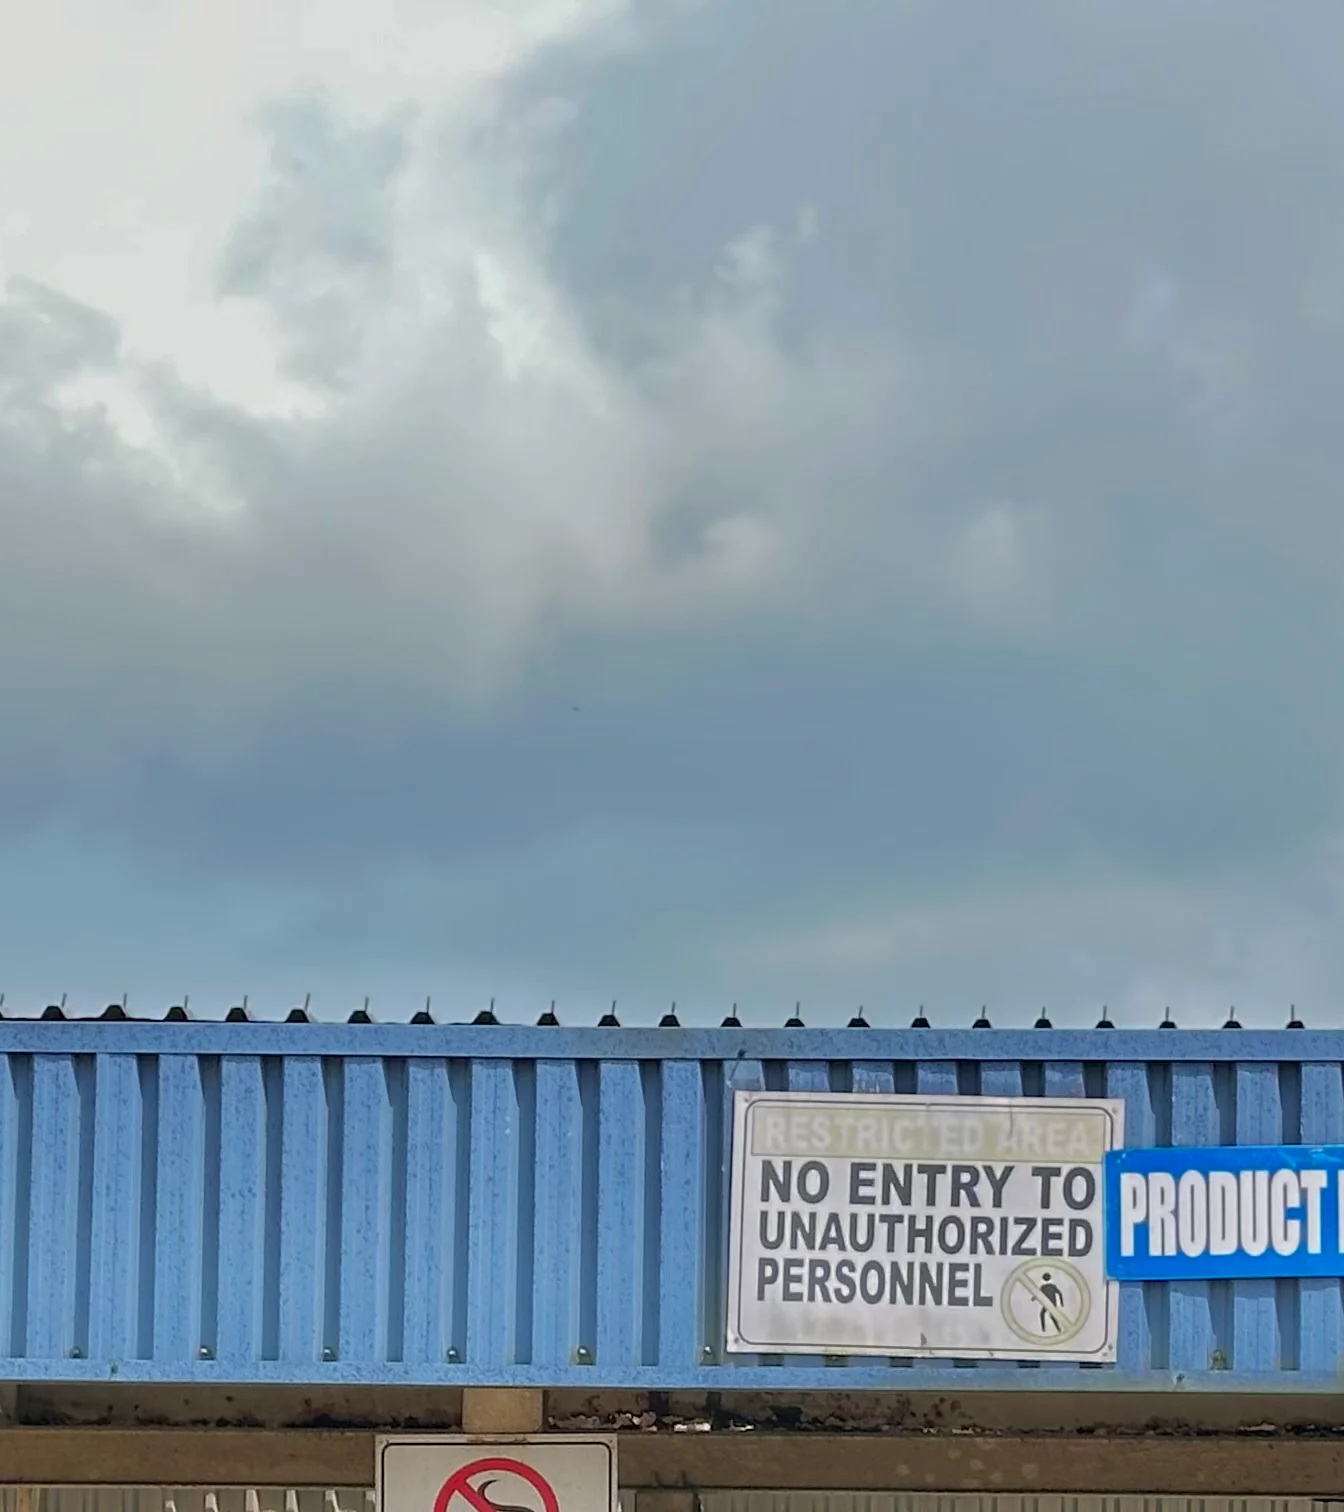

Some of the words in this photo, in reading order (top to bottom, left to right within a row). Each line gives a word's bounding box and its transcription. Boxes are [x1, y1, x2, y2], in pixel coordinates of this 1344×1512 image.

[764, 1112, 992, 1154] RESTRICTED
[995, 1117, 1090, 1155] AREA
[759, 1160, 831, 1205] NO
[849, 1162, 1015, 1209] ENTRY
[1031, 1166, 1096, 1211] TO
[758, 1210, 1093, 1257] UNAUTHORIZED
[1120, 1169, 1327, 1257] PRODUCT
[757, 1257, 994, 1308] PERSONNEL
